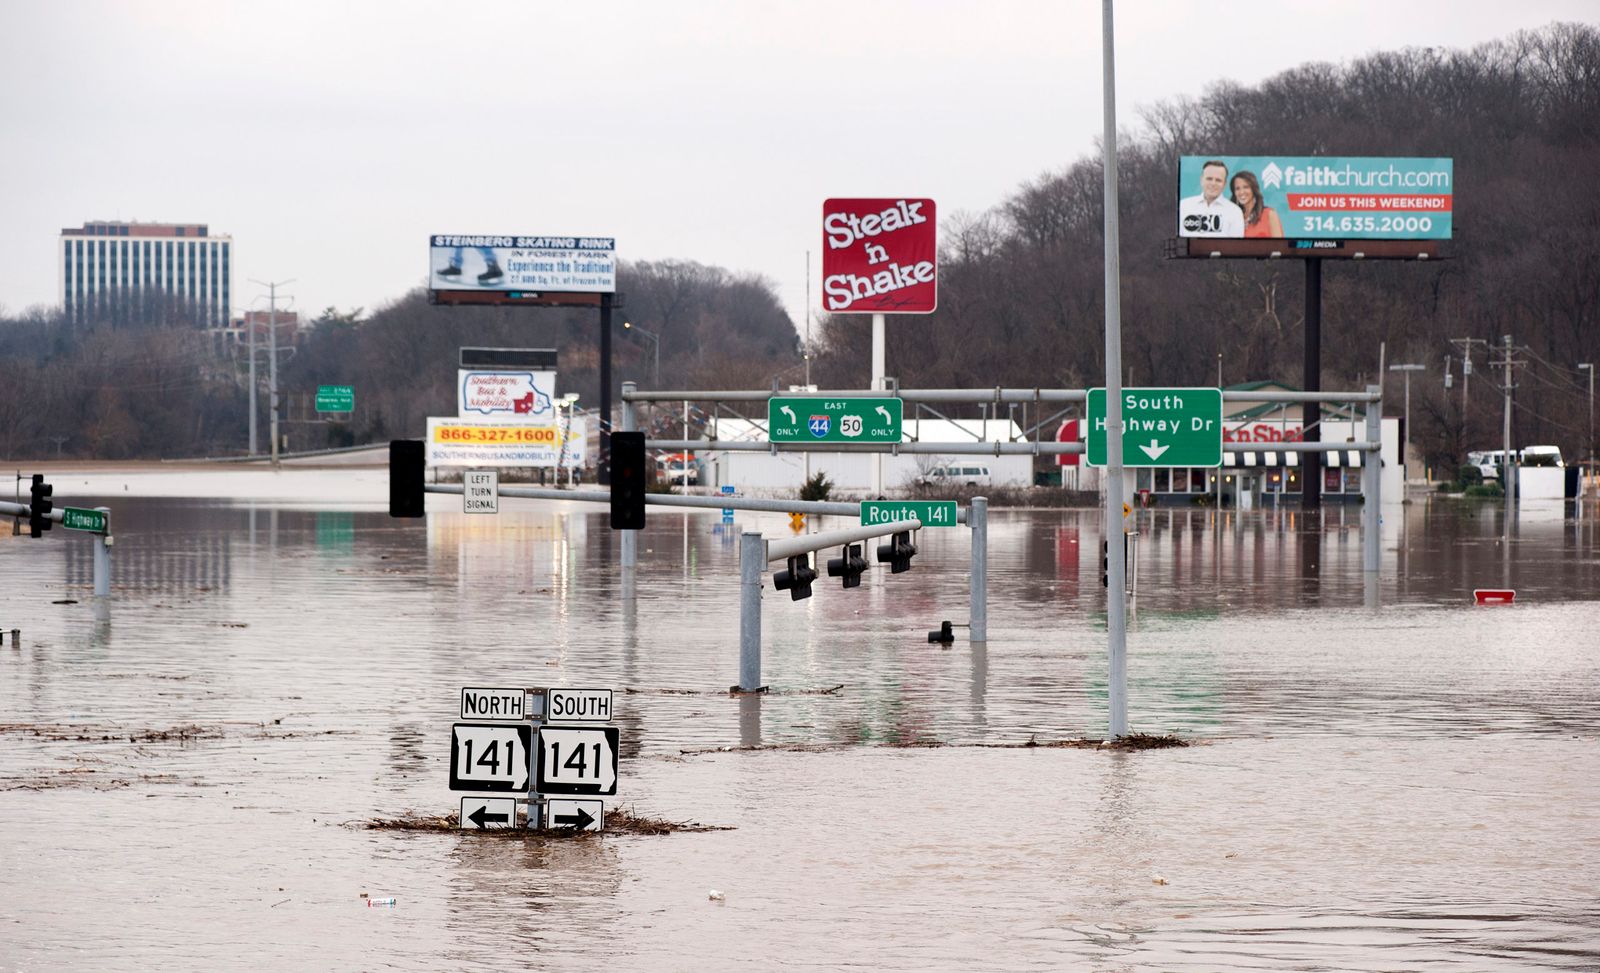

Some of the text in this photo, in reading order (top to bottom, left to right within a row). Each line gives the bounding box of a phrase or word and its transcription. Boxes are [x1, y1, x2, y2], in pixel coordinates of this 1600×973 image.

[1285, 164, 1449, 188] faithchurch.com
[1298, 197, 1445, 208] JOIN US THIS WEEKEND!
[824, 199, 927, 250] Steak
[1200, 214, 1222, 232] 30
[1303, 217, 1432, 232] 314.635.2000
[434, 236, 613, 249] STEINBERG SKATING RINK
[508, 259, 613, 274] Experience the Tradition!
[824, 260, 934, 310] Shake
[825, 402, 847, 410] EAST
[1126, 396, 1184, 409] South
[777, 428, 799, 436] ONLY
[810, 419, 861, 433] 44 50
[872, 428, 894, 437] ONLY
[1095, 417, 1213, 434] Hghway Dr
[441, 429, 555, 442] 866-327-1600
[471, 475, 491, 484] LEFT
[471, 487, 492, 497] TURN
[466, 500, 496, 509] SIGNAL
[66, 511, 101, 529] S Highway Dr
[869, 506, 949, 522] Route 141
[464, 692, 522, 715] NORTH
[552, 694, 609, 716] SOUTH
[464, 739, 514, 776] 141
[551, 741, 601, 779] 141
